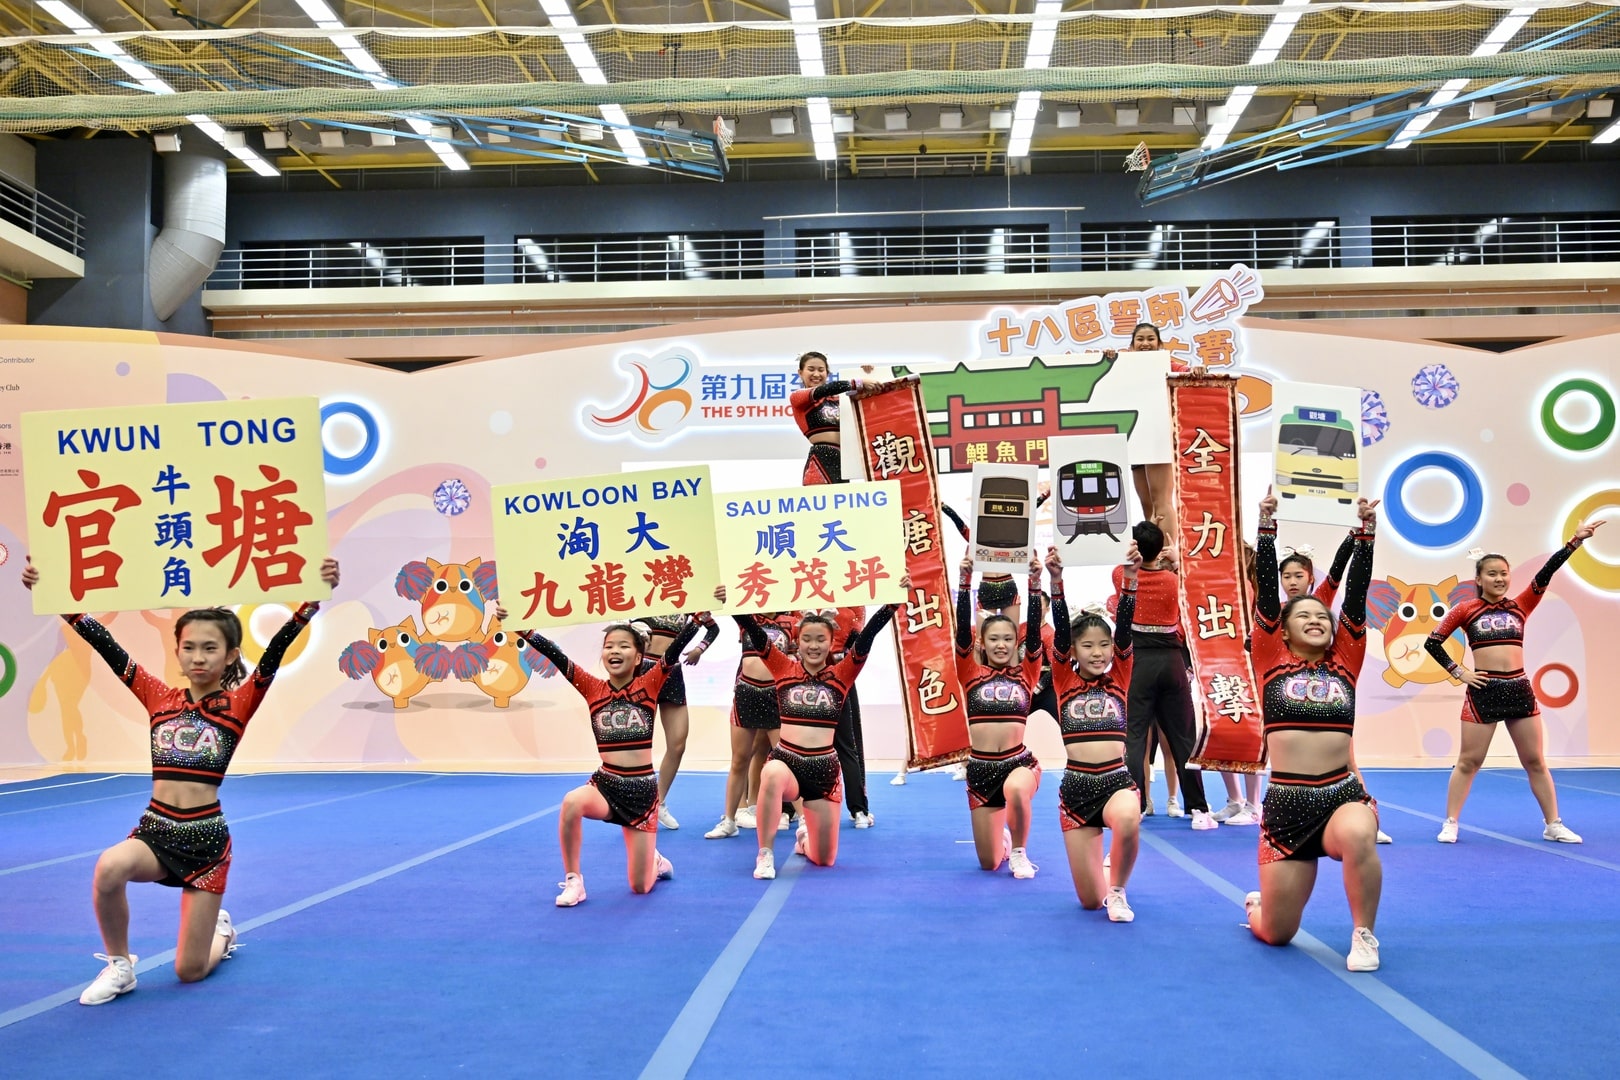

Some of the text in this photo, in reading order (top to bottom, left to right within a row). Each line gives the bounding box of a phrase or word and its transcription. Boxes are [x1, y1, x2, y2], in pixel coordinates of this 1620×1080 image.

[987, 291, 1186, 353] 十八區誓師
[701, 406, 732, 418] THE
[736, 405, 767, 418] 9TH
[57, 417, 297, 455] KWUN TONG
[965, 439, 1048, 465] 鯉魚門
[504, 477, 704, 515] KOWLOON BAY
[726, 490, 889, 518] SAU MAU PING
[1006, 505, 1018, 513] 101
[152, 465, 193, 597] 牛頭角
[556, 511, 671, 561] 淘大
[755, 519, 857, 559] 順天
[520, 554, 694, 621] 九龍灣
[735, 555, 891, 608] 秀茂坪
[1181, 428, 1255, 724] 全力出擊
[1477, 614, 1521, 632] CCA
[789, 688, 832, 707] CCA
[981, 685, 1025, 702] CCA
[1286, 679, 1348, 704] CCA
[596, 709, 647, 730] CCA
[1070, 699, 1121, 720] CCA
[155, 725, 219, 753] CCA
